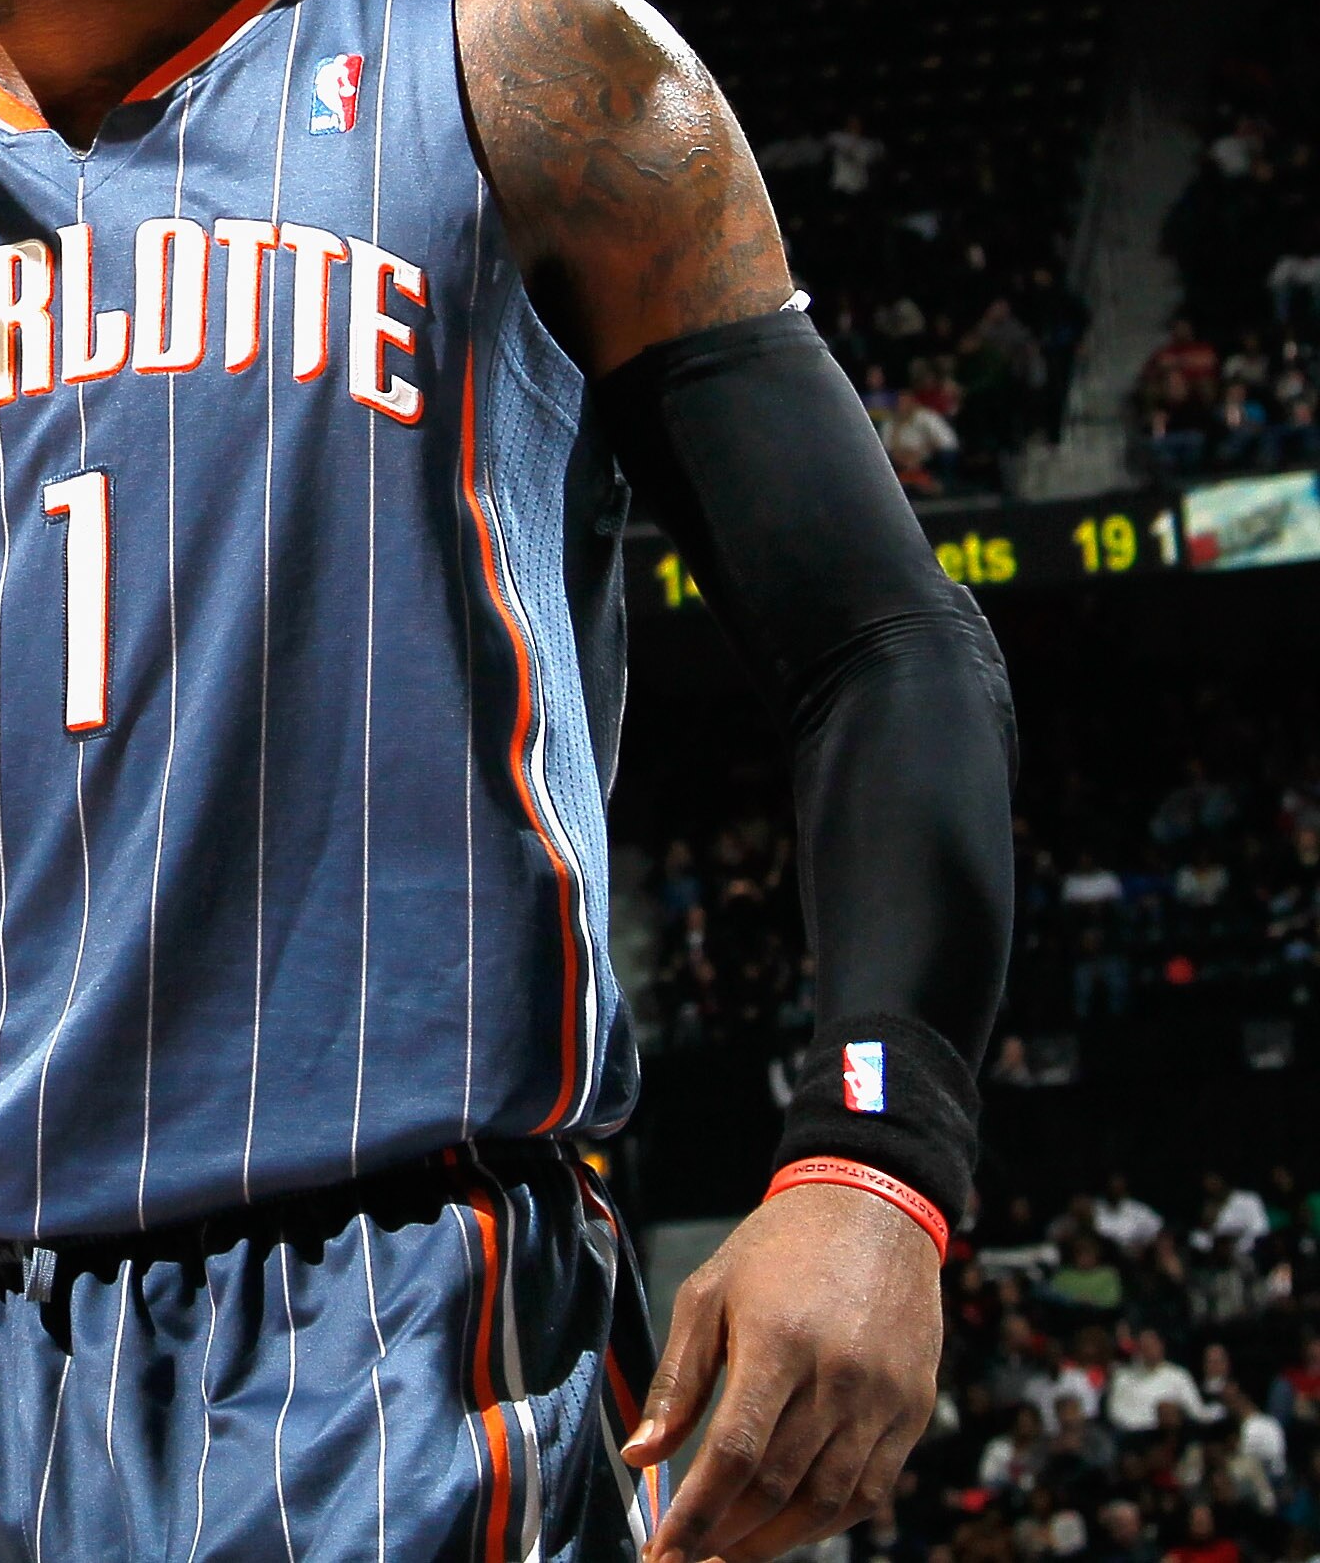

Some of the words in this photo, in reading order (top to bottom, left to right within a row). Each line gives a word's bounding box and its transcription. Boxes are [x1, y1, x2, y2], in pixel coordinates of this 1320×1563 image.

[41, 470, 111, 733] 1
[934, 532, 1018, 584] ets
[1073, 513, 1137, 573] 19
